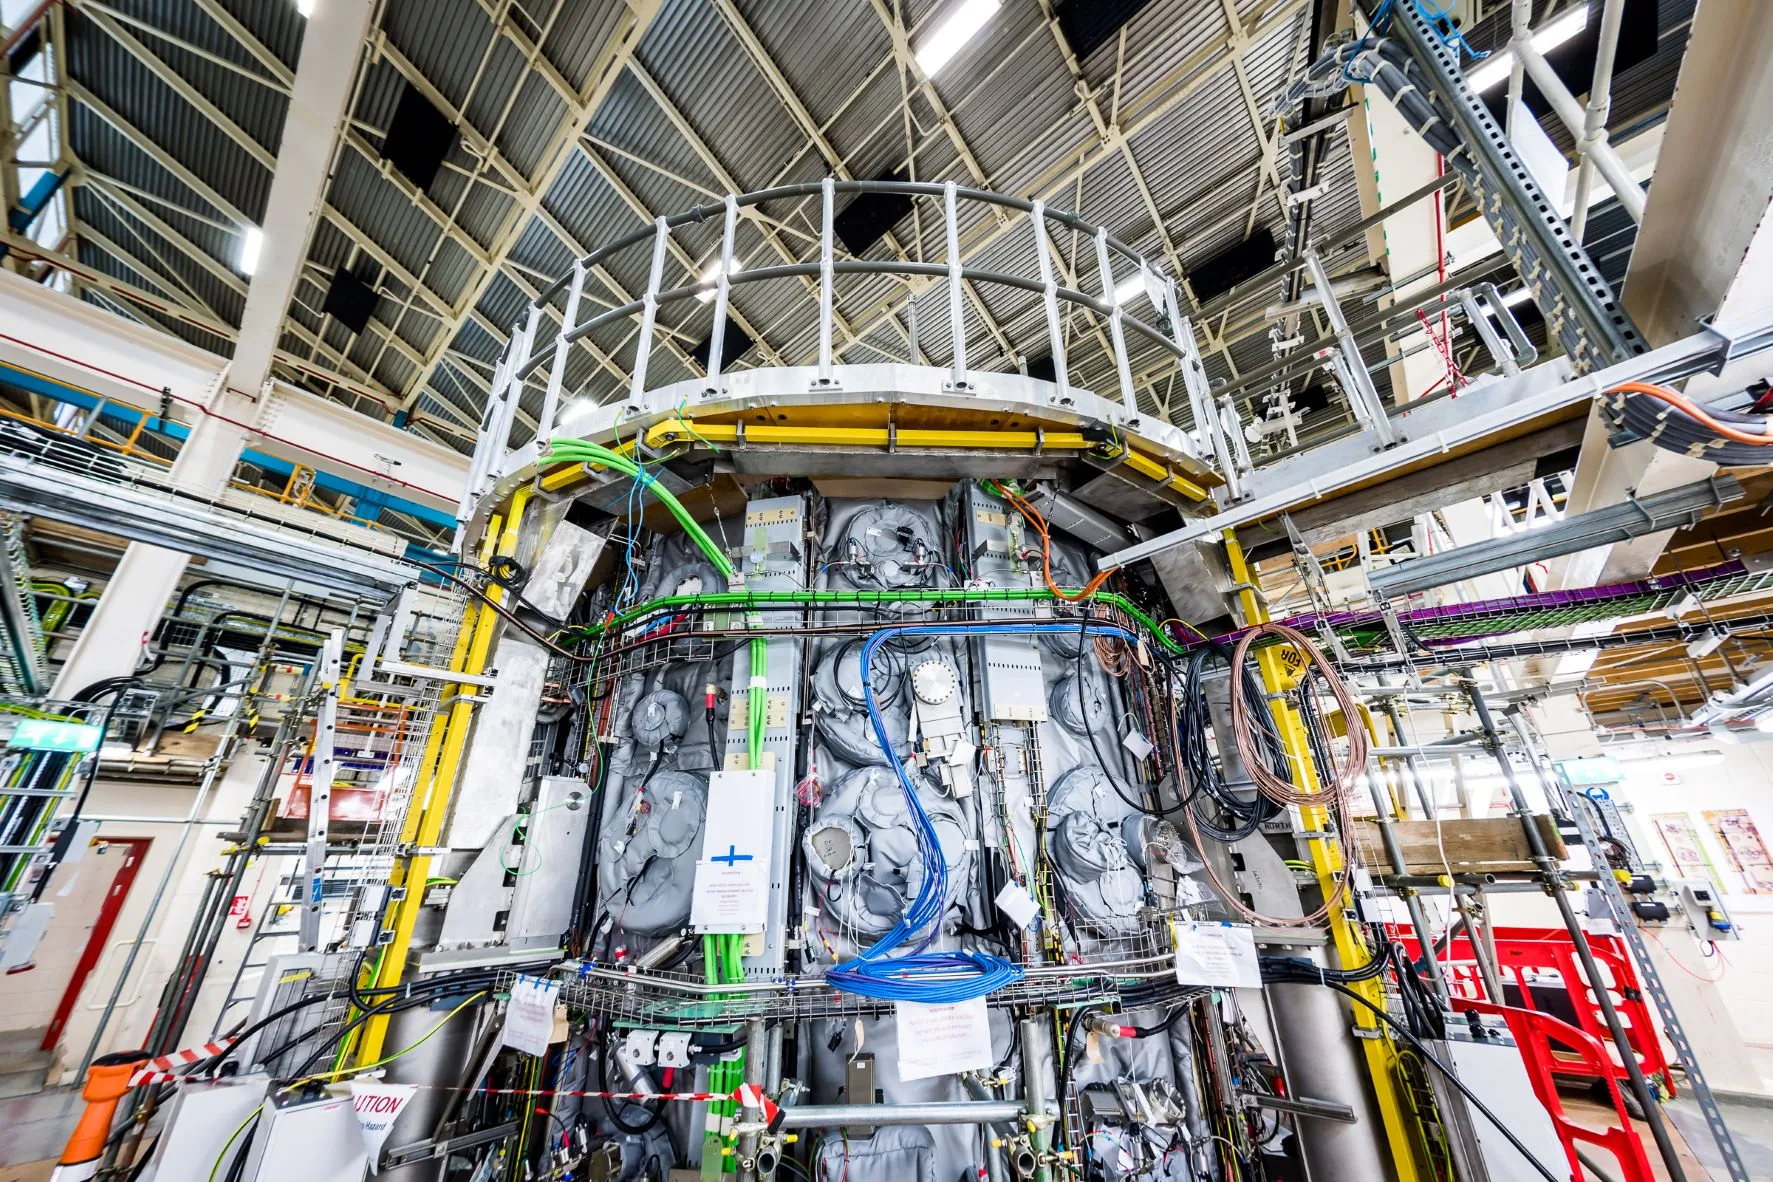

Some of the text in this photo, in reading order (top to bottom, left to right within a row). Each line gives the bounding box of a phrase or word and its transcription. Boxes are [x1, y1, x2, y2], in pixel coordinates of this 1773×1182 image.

[1281, 649, 1301, 667] FOR
[352, 1095, 404, 1113] UTION
[365, 1121, 388, 1131] Hazard
